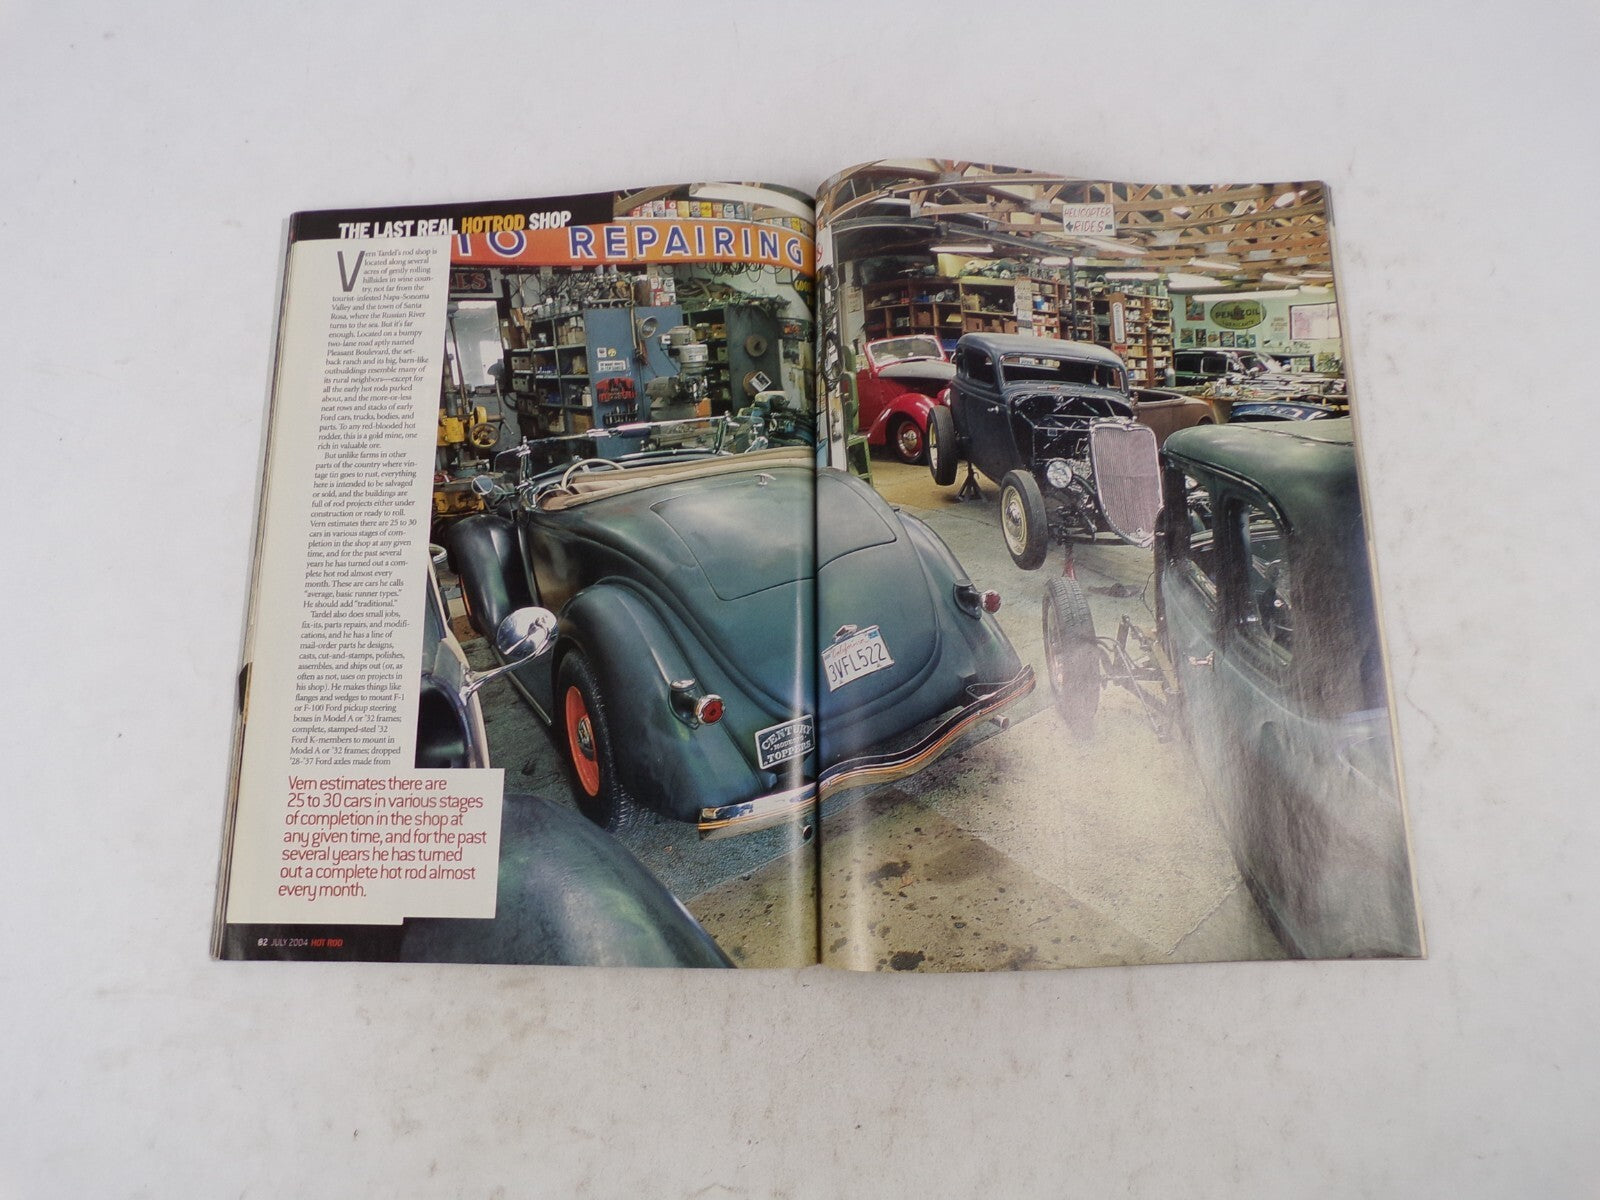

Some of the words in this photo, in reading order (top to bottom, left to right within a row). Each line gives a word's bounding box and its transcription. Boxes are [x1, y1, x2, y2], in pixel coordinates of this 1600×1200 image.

[339, 222, 370, 239] THE
[374, 220, 414, 238] LAST
[417, 218, 458, 236] REAL
[462, 214, 525, 234] HOTROD
[528, 210, 572, 230] SHOP
[1073, 220, 1104, 232] RIDES
[568, 225, 804, 267] REPAIRING
[336, 250, 376, 292] Vern
[415, 247, 431, 257] shop
[350, 311, 369, 319] where
[382, 310, 407, 318] Russian
[327, 348, 354, 356] Pleasant
[324, 366, 367, 376] outbuildings
[368, 365, 397, 373] resemble
[320, 413, 336, 421] Ford
[337, 450, 359, 458] unlike
[360, 450, 380, 458] farms
[389, 449, 407, 457] other
[311, 499, 323, 507] full
[346, 499, 373, 508] projects
[374, 498, 393, 506] either
[310, 518, 327, 526] Vern
[390, 517, 399, 525] 25
[409, 517, 417, 525] 30
[305, 579, 330, 587] month.
[333, 579, 352, 587] These
[379, 578, 388, 586] he
[389, 578, 404, 586] calls
[310, 610, 332, 618] Tardel
[333, 609, 348, 617] also
[348, 609, 365, 617] does
[365, 609, 384, 617] small
[385, 609, 401, 619] jobs,
[324, 621, 342, 630] parts
[343, 621, 368, 630] repairs,
[369, 620, 383, 628] and
[338, 641, 356, 651] parts
[367, 640, 395, 651] designs,
[829, 643, 886, 682] 3VFL522
[296, 682, 307, 690] his
[307, 681, 330, 692] shop).
[331, 681, 342, 690] He
[343, 681, 366, 690] makes
[366, 681, 388, 692] things
[389, 681, 402, 690] like
[295, 693, 319, 703] flanges
[320, 693, 334, 701] and
[334, 693, 360, 703] wedges
[369, 693, 393, 701] mount
[325, 702, 343, 710] Ford
[343, 702, 369, 713] pickup
[369, 703, 397, 713] steering
[291, 734, 308, 742] Ford
[762, 724, 812, 750] CENTURY
[767, 740, 811, 763] TOPPERS
[315, 756, 333, 765] Ford
[333, 756, 352, 765] axles
[352, 756, 372, 765] made
[373, 756, 391, 765] from
[287, 776, 317, 791] Vern
[320, 777, 385, 790] estimates
[389, 777, 422, 790] there
[425, 779, 447, 790] are
[287, 793, 304, 807] 25
[307, 795, 320, 807] to
[323, 793, 341, 807] 30
[343, 796, 371, 807] cars
[374, 793, 385, 807] in
[388, 794, 436, 808] various
[440, 795, 483, 812] stages
[286, 811, 300, 825] of
[300, 811, 373, 829] completion
[377, 811, 387, 825] in
[391, 812, 412, 826] the
[415, 812, 448, 830] shop
[450, 813, 463, 826] at
[284, 831, 308, 848] any
[312, 828, 348, 847] given
[351, 829, 383, 845] time,
[385, 830, 410, 844] and
[414, 830, 434, 844] for
[434, 830, 455, 844] the
[458, 831, 487, 847] past
[282, 847, 330, 861] several
[333, 850, 370, 865] years
[373, 848, 388, 861] he
[391, 848, 415, 862] has
[419, 848, 462, 862] turned
[280, 866, 301, 878] out
[306, 868, 313, 878] a
[316, 865, 377, 883] complete
[380, 865, 401, 879] hot
[405, 865, 427, 879] rod
[429, 865, 475, 879] almost
[279, 885, 316, 901] every
[319, 883, 367, 897] month.
[311, 939, 324, 947] HOT
